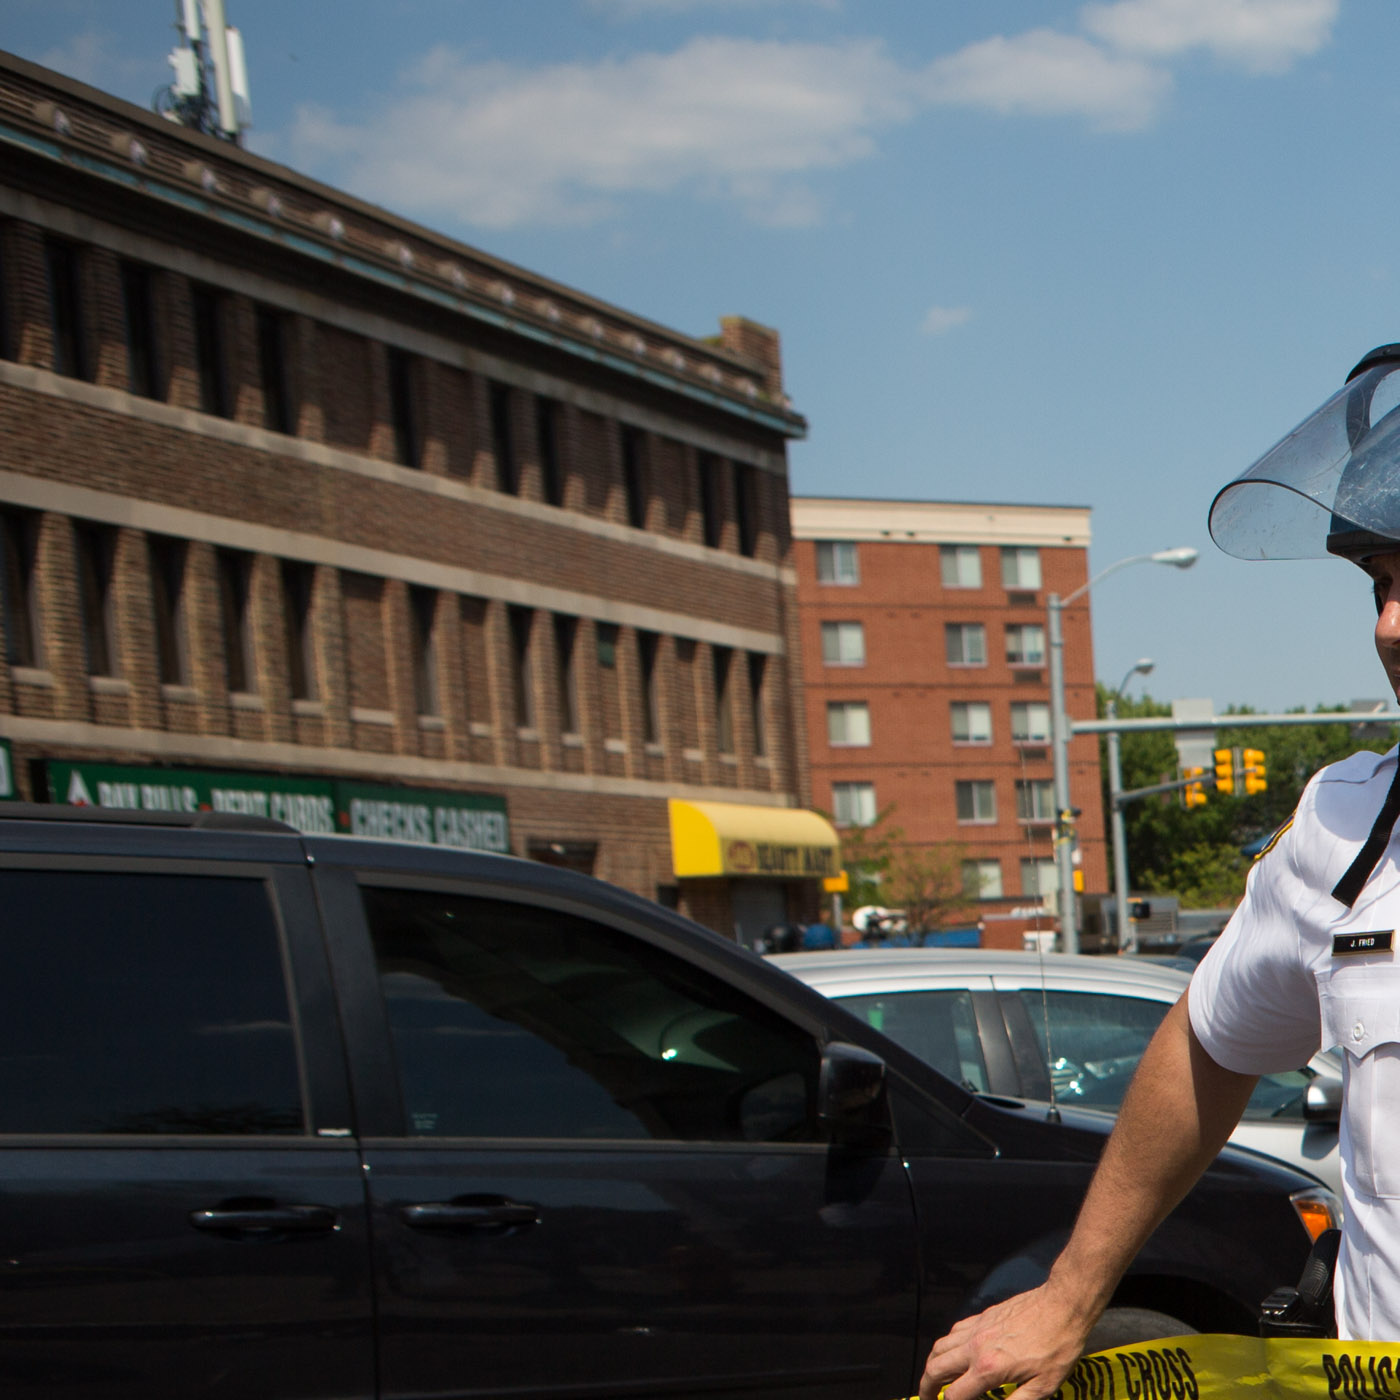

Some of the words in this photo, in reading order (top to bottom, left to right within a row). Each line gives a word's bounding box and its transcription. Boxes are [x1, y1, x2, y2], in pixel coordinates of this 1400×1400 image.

[352, 799, 432, 843] CHECKS
[433, 806, 510, 854] CASHED
[1358, 938, 1375, 947] FRIED
